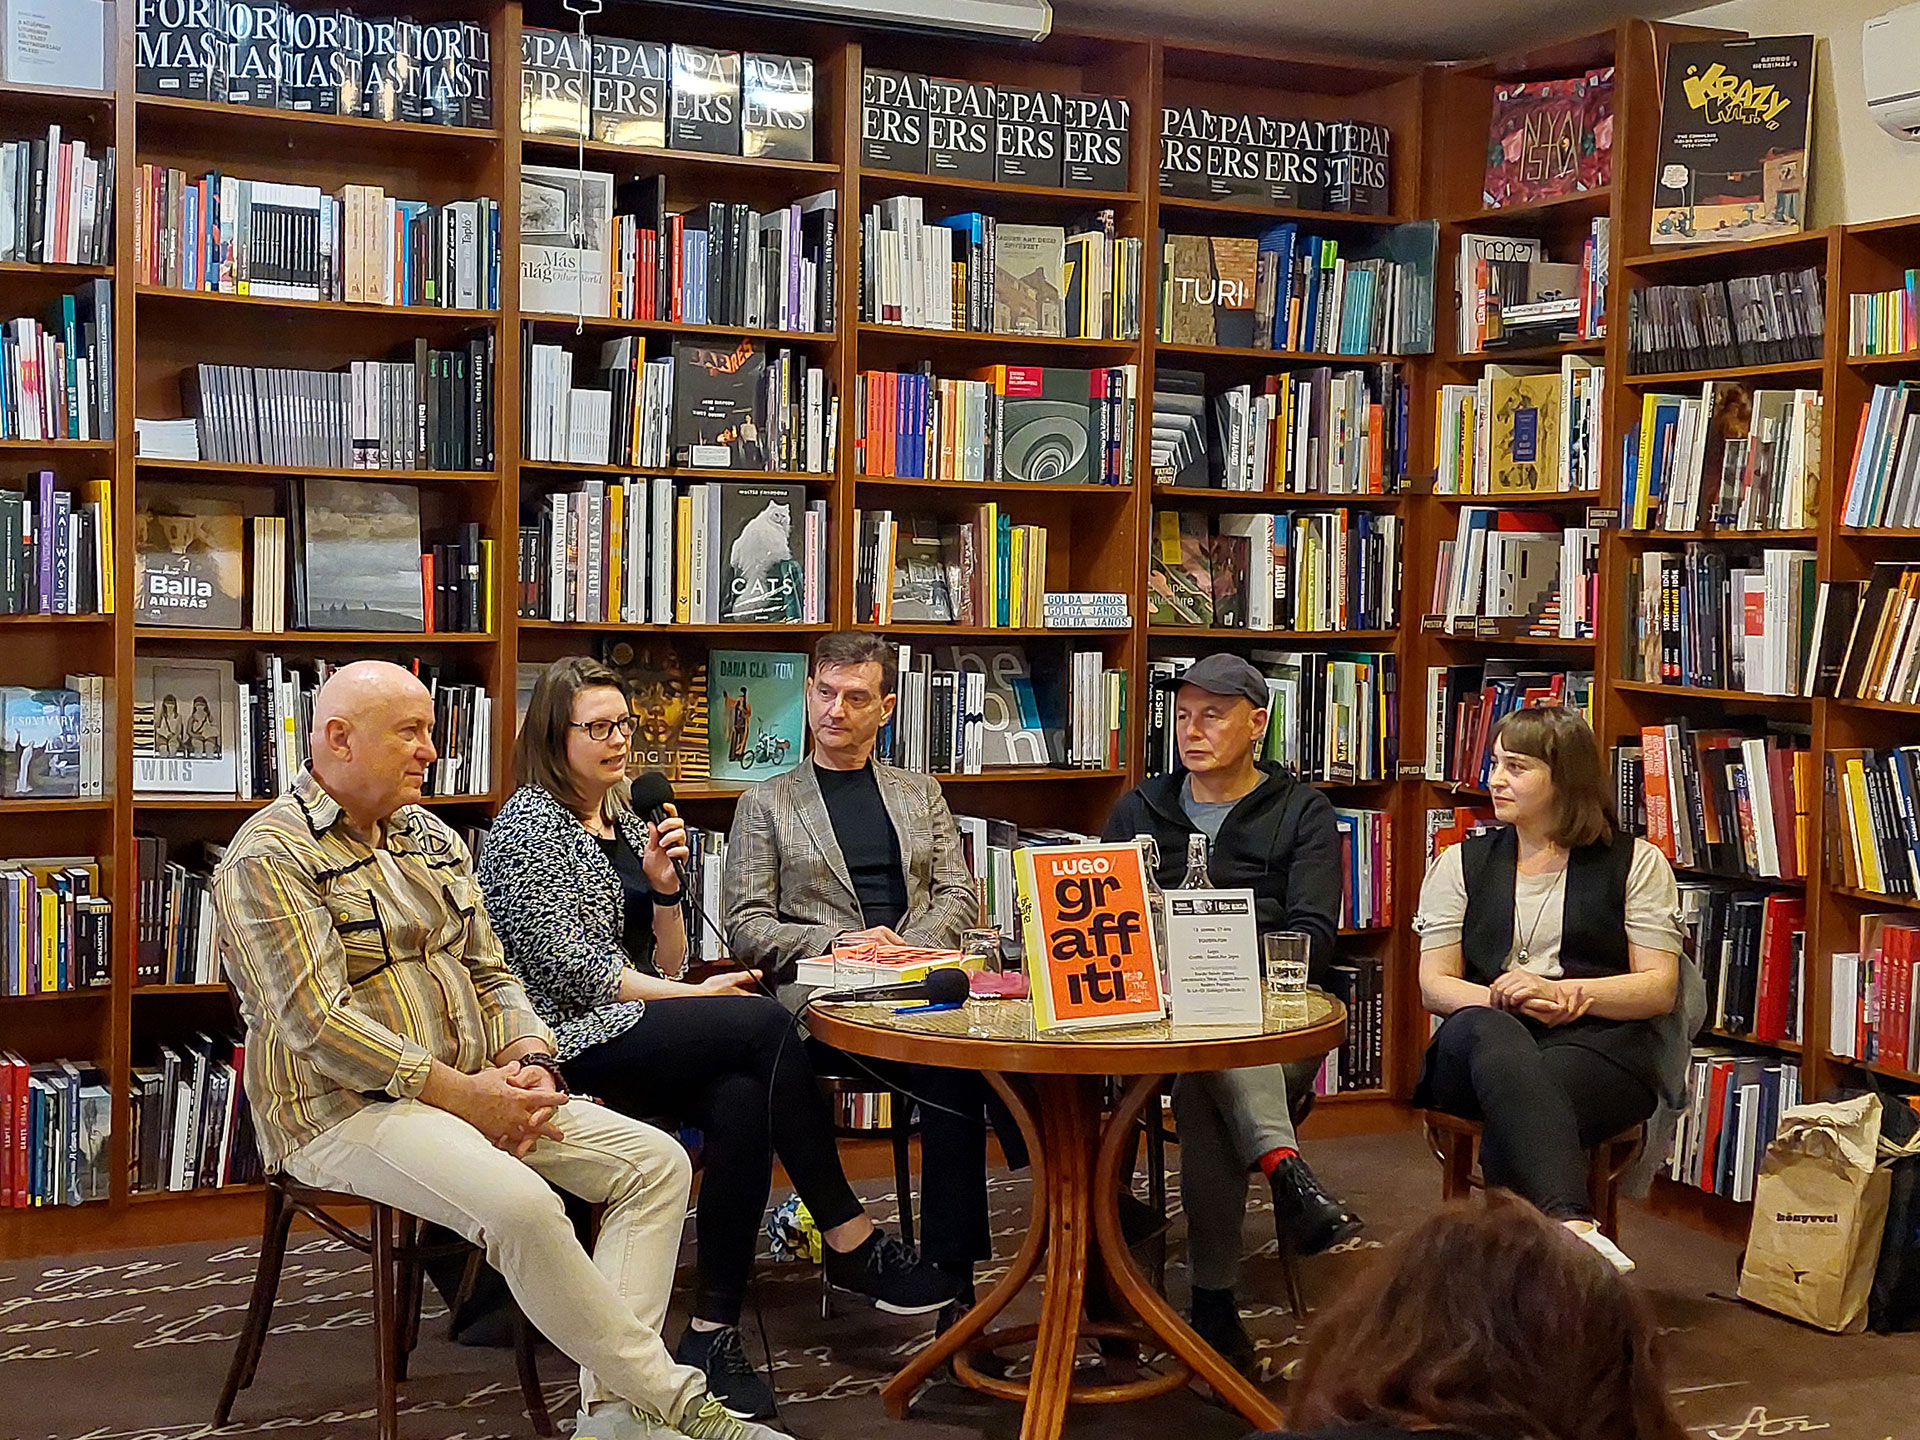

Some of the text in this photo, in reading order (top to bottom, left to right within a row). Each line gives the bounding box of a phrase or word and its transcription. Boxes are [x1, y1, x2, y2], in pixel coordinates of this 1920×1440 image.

[593, 78, 658, 116] ERS
[673, 92, 733, 124] ERS
[1683, 63, 1791, 122] KRAZY
[863, 108, 920, 145] ERS
[929, 117, 987, 153] ERS
[997, 124, 1054, 160] ERS
[1065, 131, 1122, 166] ERS
[1207, 146, 1258, 179] ERS
[1265, 151, 1317, 184] ERS
[543, 250, 576, 269] Más
[1175, 278, 1243, 307] TURI
[588, 496, 600, 525] IT'S
[56, 505, 67, 590] RAILWAYS
[555, 499, 565, 576] HELMUT NEWTON
[150, 575, 212, 598] Balla
[588, 558, 600, 598] TRUE
[731, 578, 793, 595] CATS
[1275, 565, 1286, 598] ARAD
[149, 596, 208, 608] ANDRÁS
[1047, 595, 1081, 604] GOLDA
[1048, 606, 1082, 615] GOLDA
[1052, 617, 1087, 626] GOLDA
[720, 660, 746, 678] DANA
[1155, 701, 1164, 729] SHED
[1055, 874, 1122, 921] gr
[1050, 911, 1141, 961] aff
